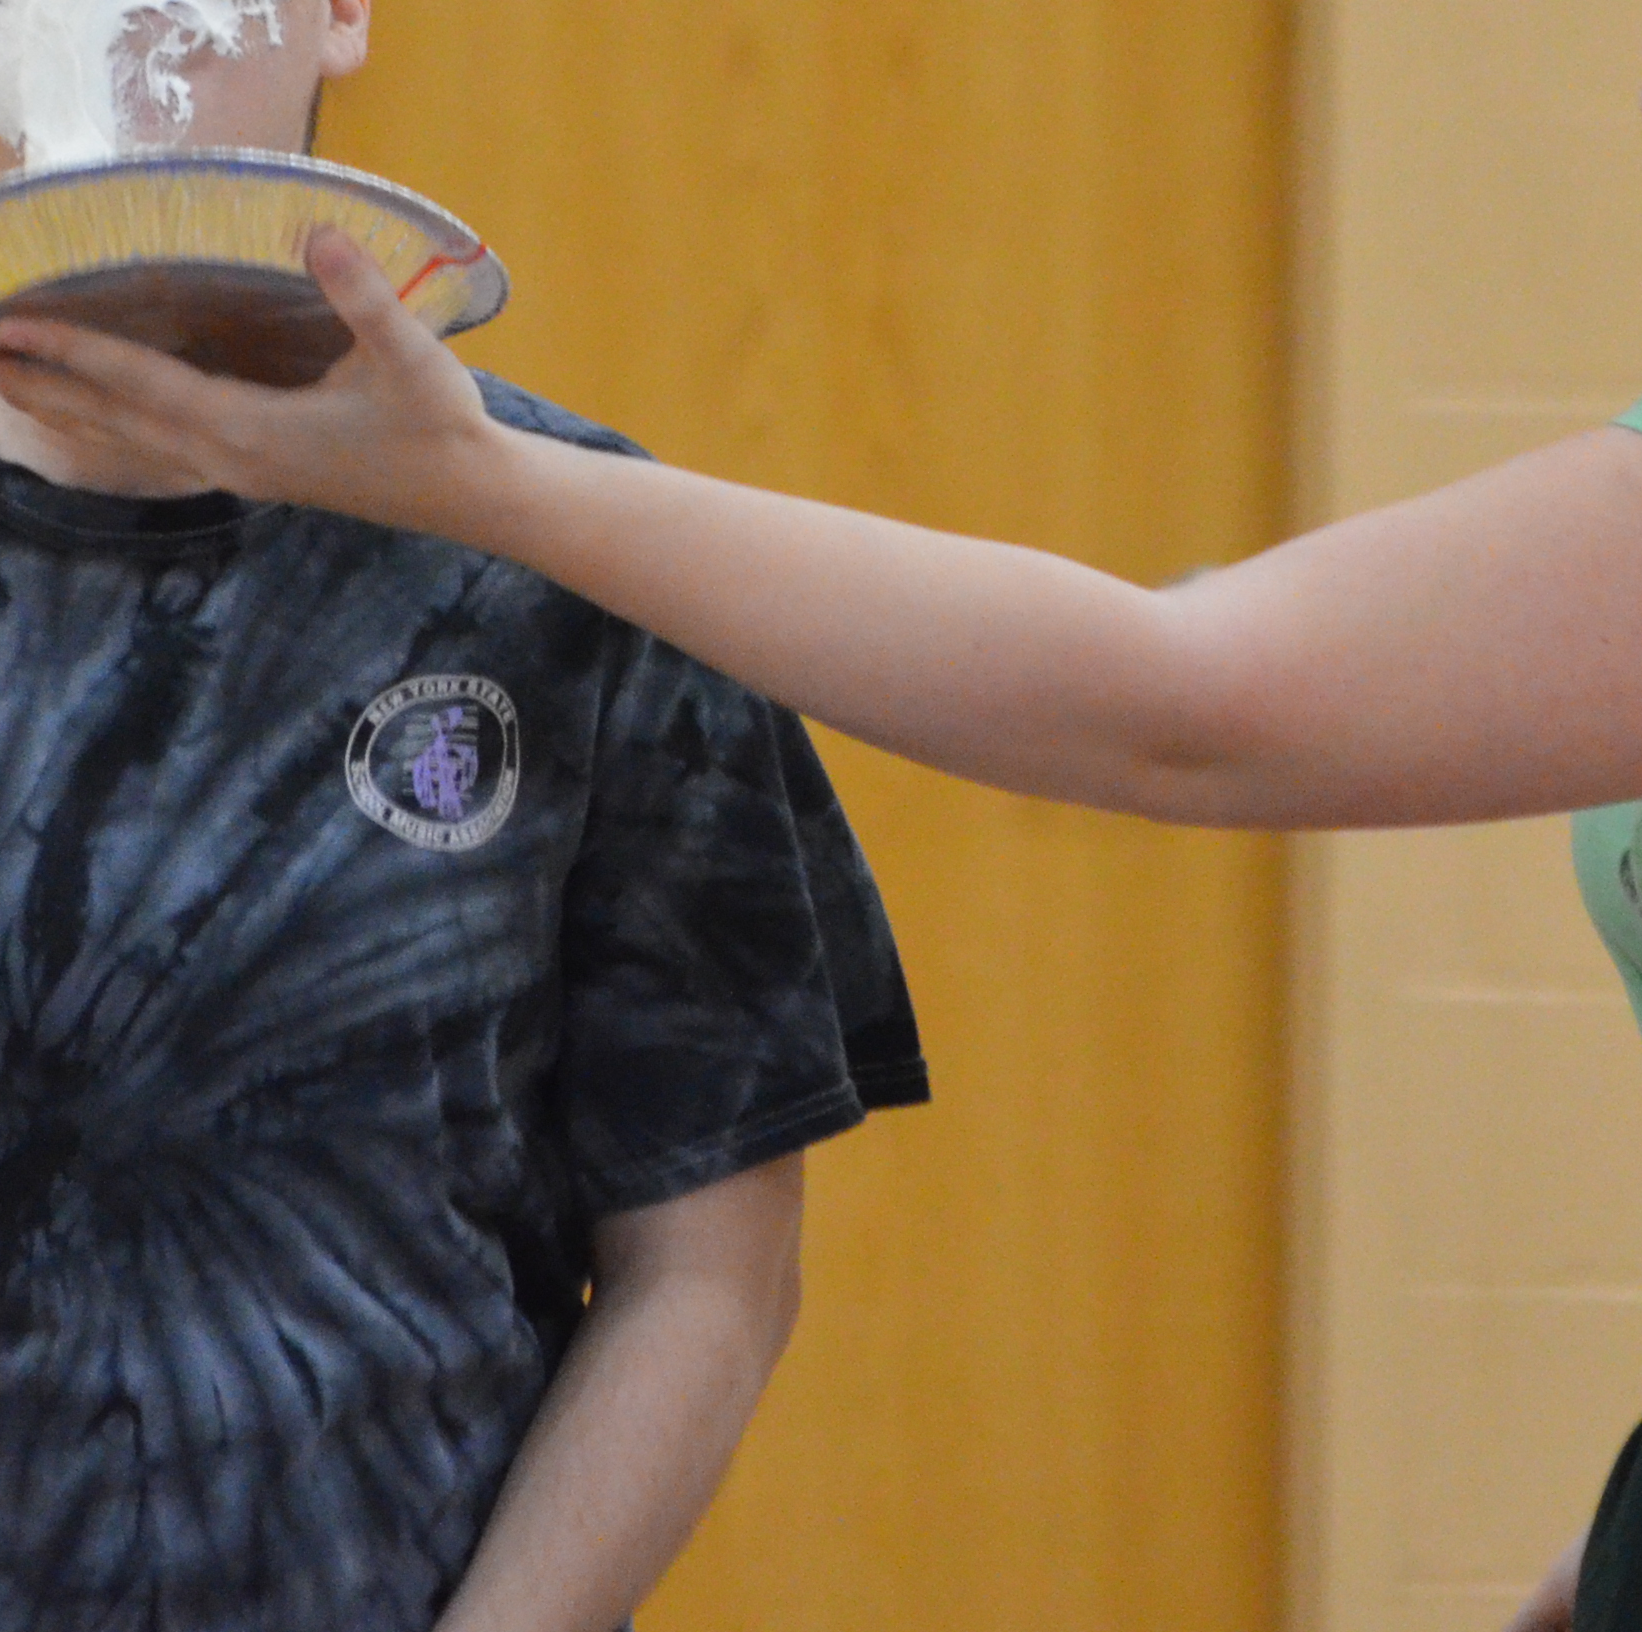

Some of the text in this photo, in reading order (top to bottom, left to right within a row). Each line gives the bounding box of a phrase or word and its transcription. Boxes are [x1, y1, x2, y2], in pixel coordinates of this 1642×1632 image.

[366, 679, 514, 725] NEW YORK STATE
